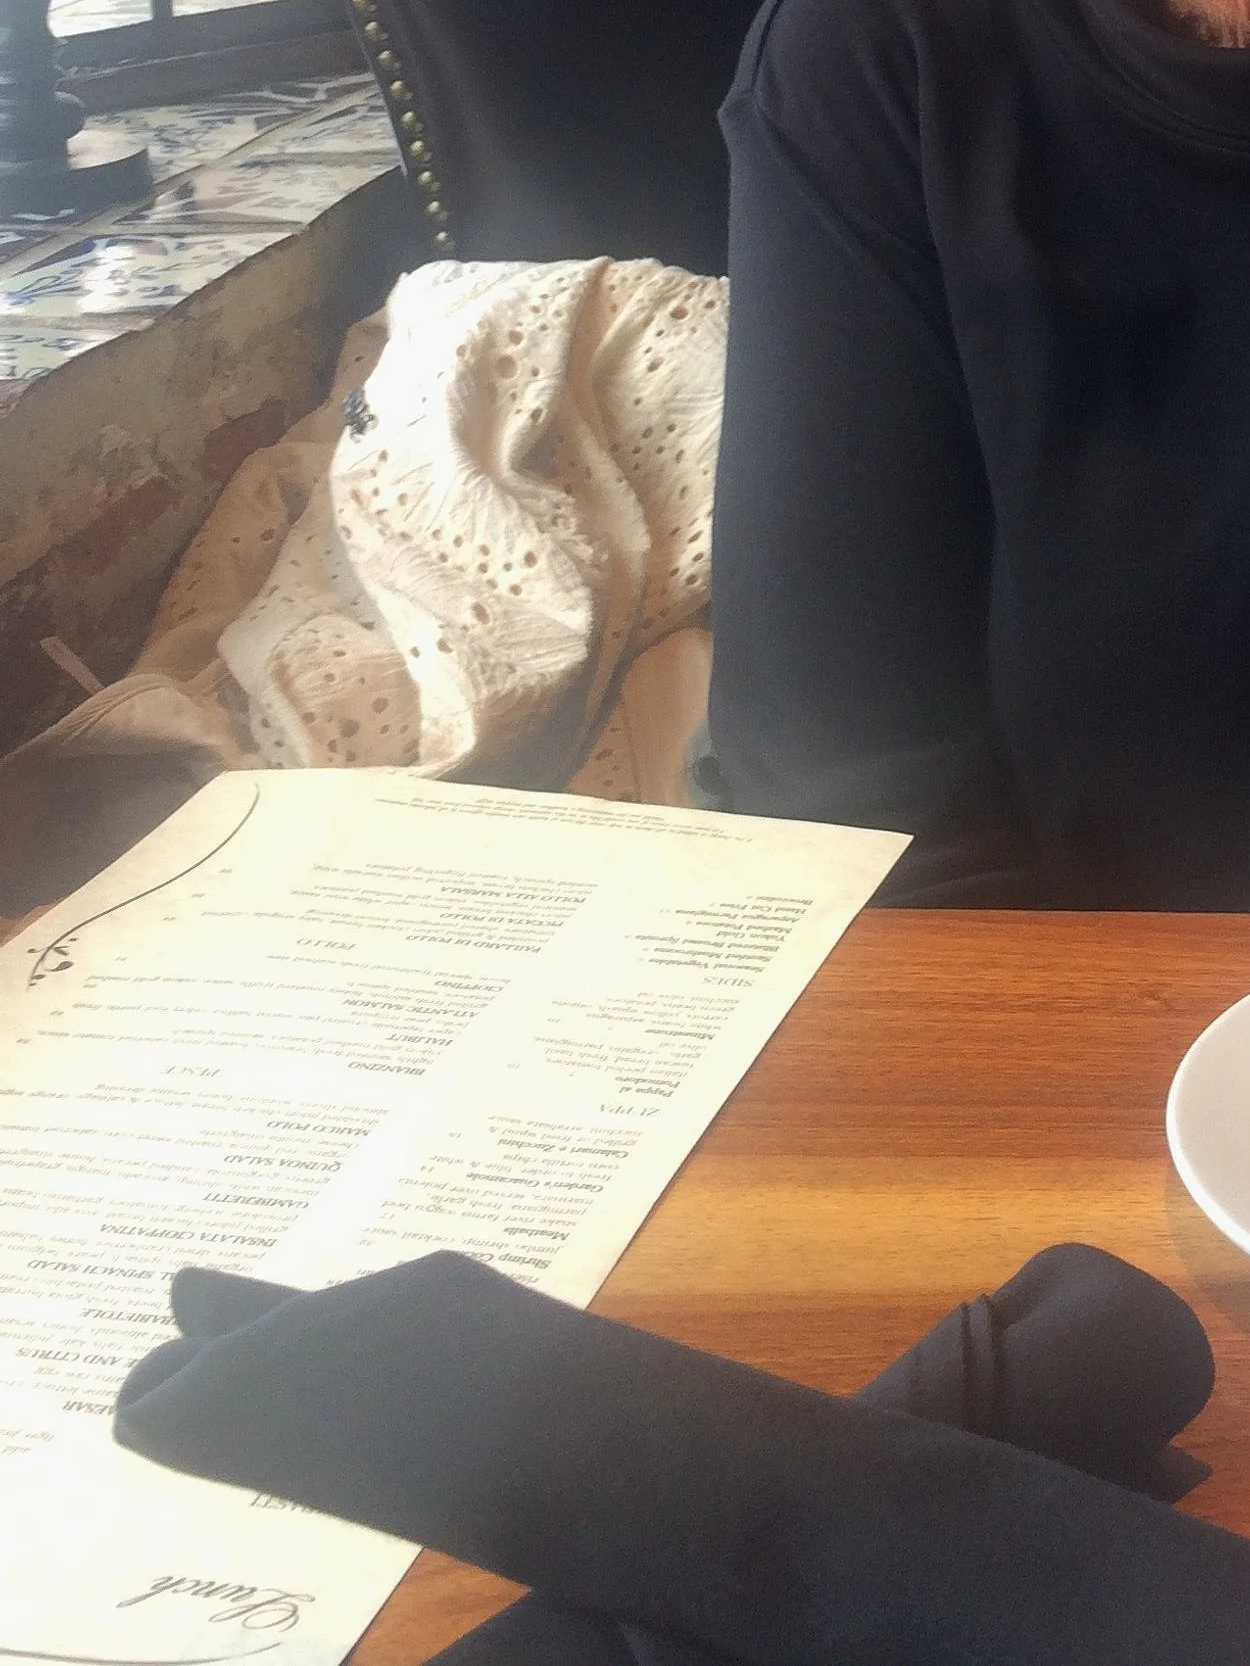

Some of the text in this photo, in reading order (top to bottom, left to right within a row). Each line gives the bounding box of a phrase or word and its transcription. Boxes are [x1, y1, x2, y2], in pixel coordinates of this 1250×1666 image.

[434, 981, 504, 992] CIOPPINO
[703, 977, 755, 987] SIDES
[342, 999, 480, 1018] ATLANTIC SALMON
[386, 1033, 453, 1046] HALIBUT
[348, 1062, 426, 1076] BRANZINO
[600, 1104, 660, 1117] ZUPPA
[266, 1121, 371, 1137] MARCO POLO
[497, 1138, 556, 1152] Zucchini
[569, 1147, 629, 1158] Calamari
[224, 1153, 343, 1172] QUINOA SALAD
[466, 1172, 540, 1189] Guacamole
[544, 1181, 603, 1193] Garden's
[202, 1193, 309, 1209] GAMBERETTI
[100, 1223, 277, 1247] INSALATA CIOPPATINA
[503, 1227, 570, 1241] Meatballs
[498, 1253, 551, 1269] Shrimp
[26, 1260, 155, 1279] SPINACH SALAD
[80, 1309, 174, 1325] BABIETOLE
[16, 1348, 122, 1366] AND CITRUS
[62, 1400, 118, 1415] AESAR
[116, 1576, 315, 1632] Lunch
